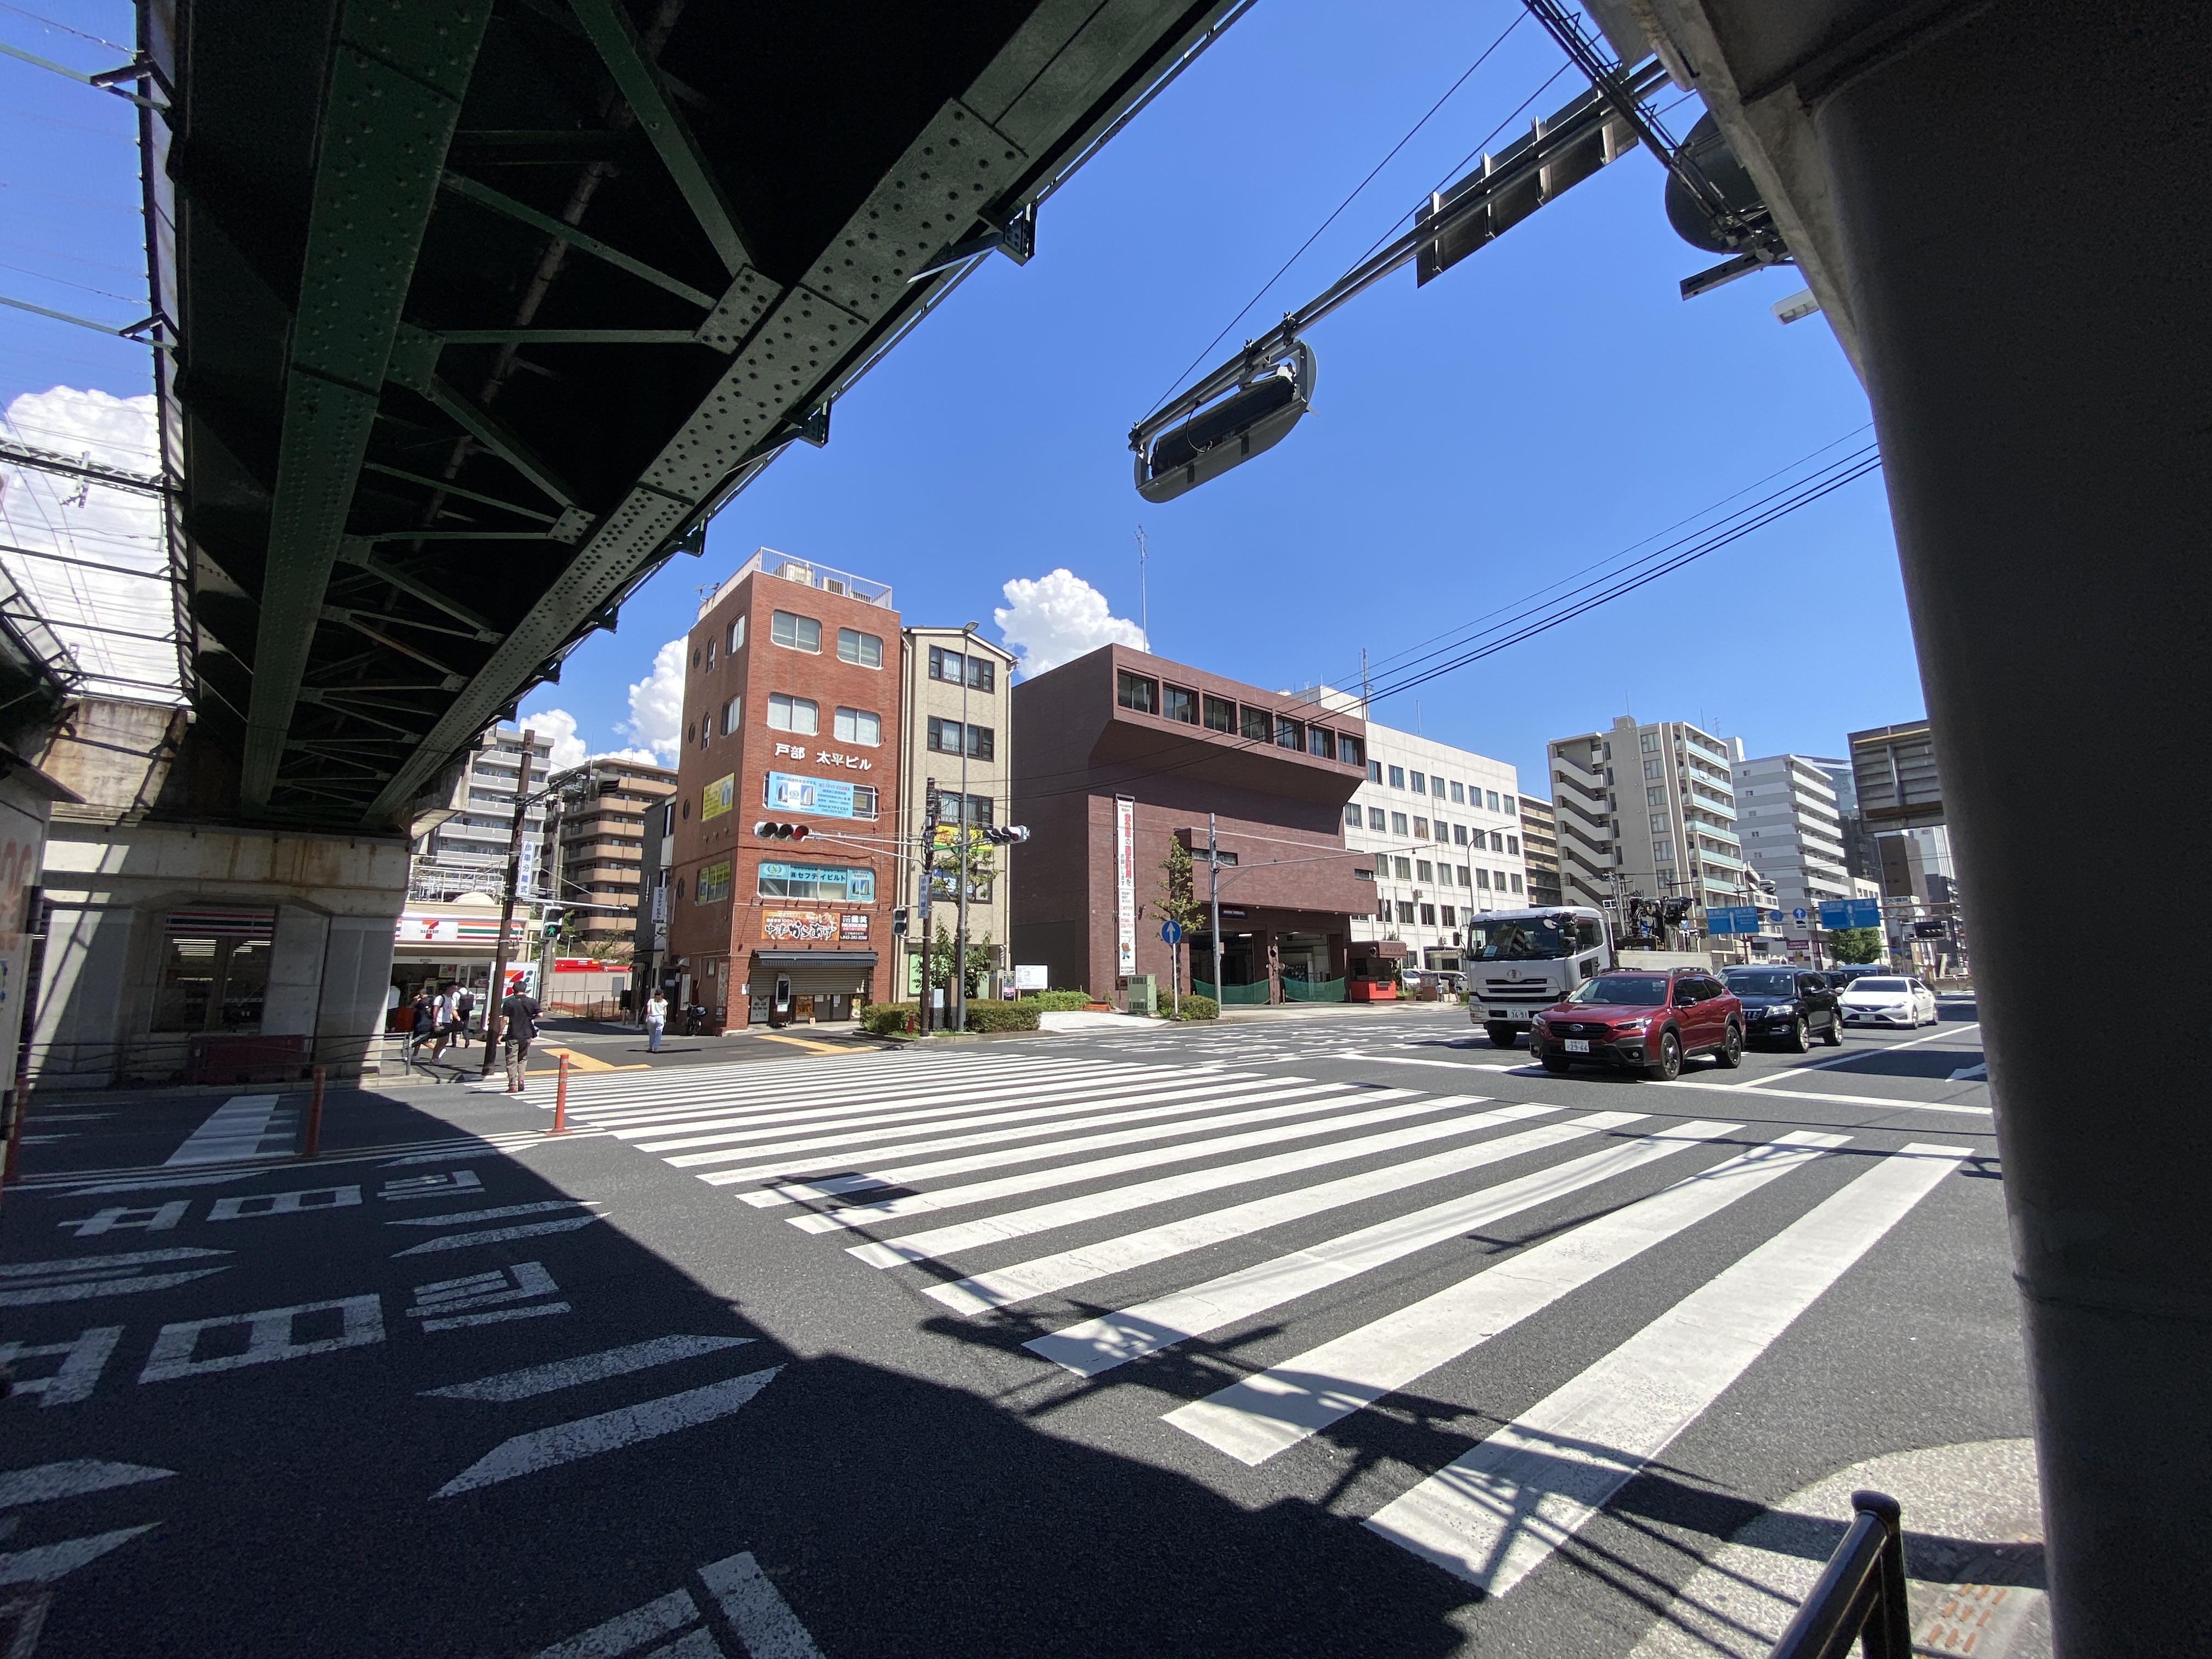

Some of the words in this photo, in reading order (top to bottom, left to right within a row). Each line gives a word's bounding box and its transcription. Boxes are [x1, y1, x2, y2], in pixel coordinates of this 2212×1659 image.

[775, 743, 806, 760] 戸部
[816, 751, 872, 771] 太平ビル
